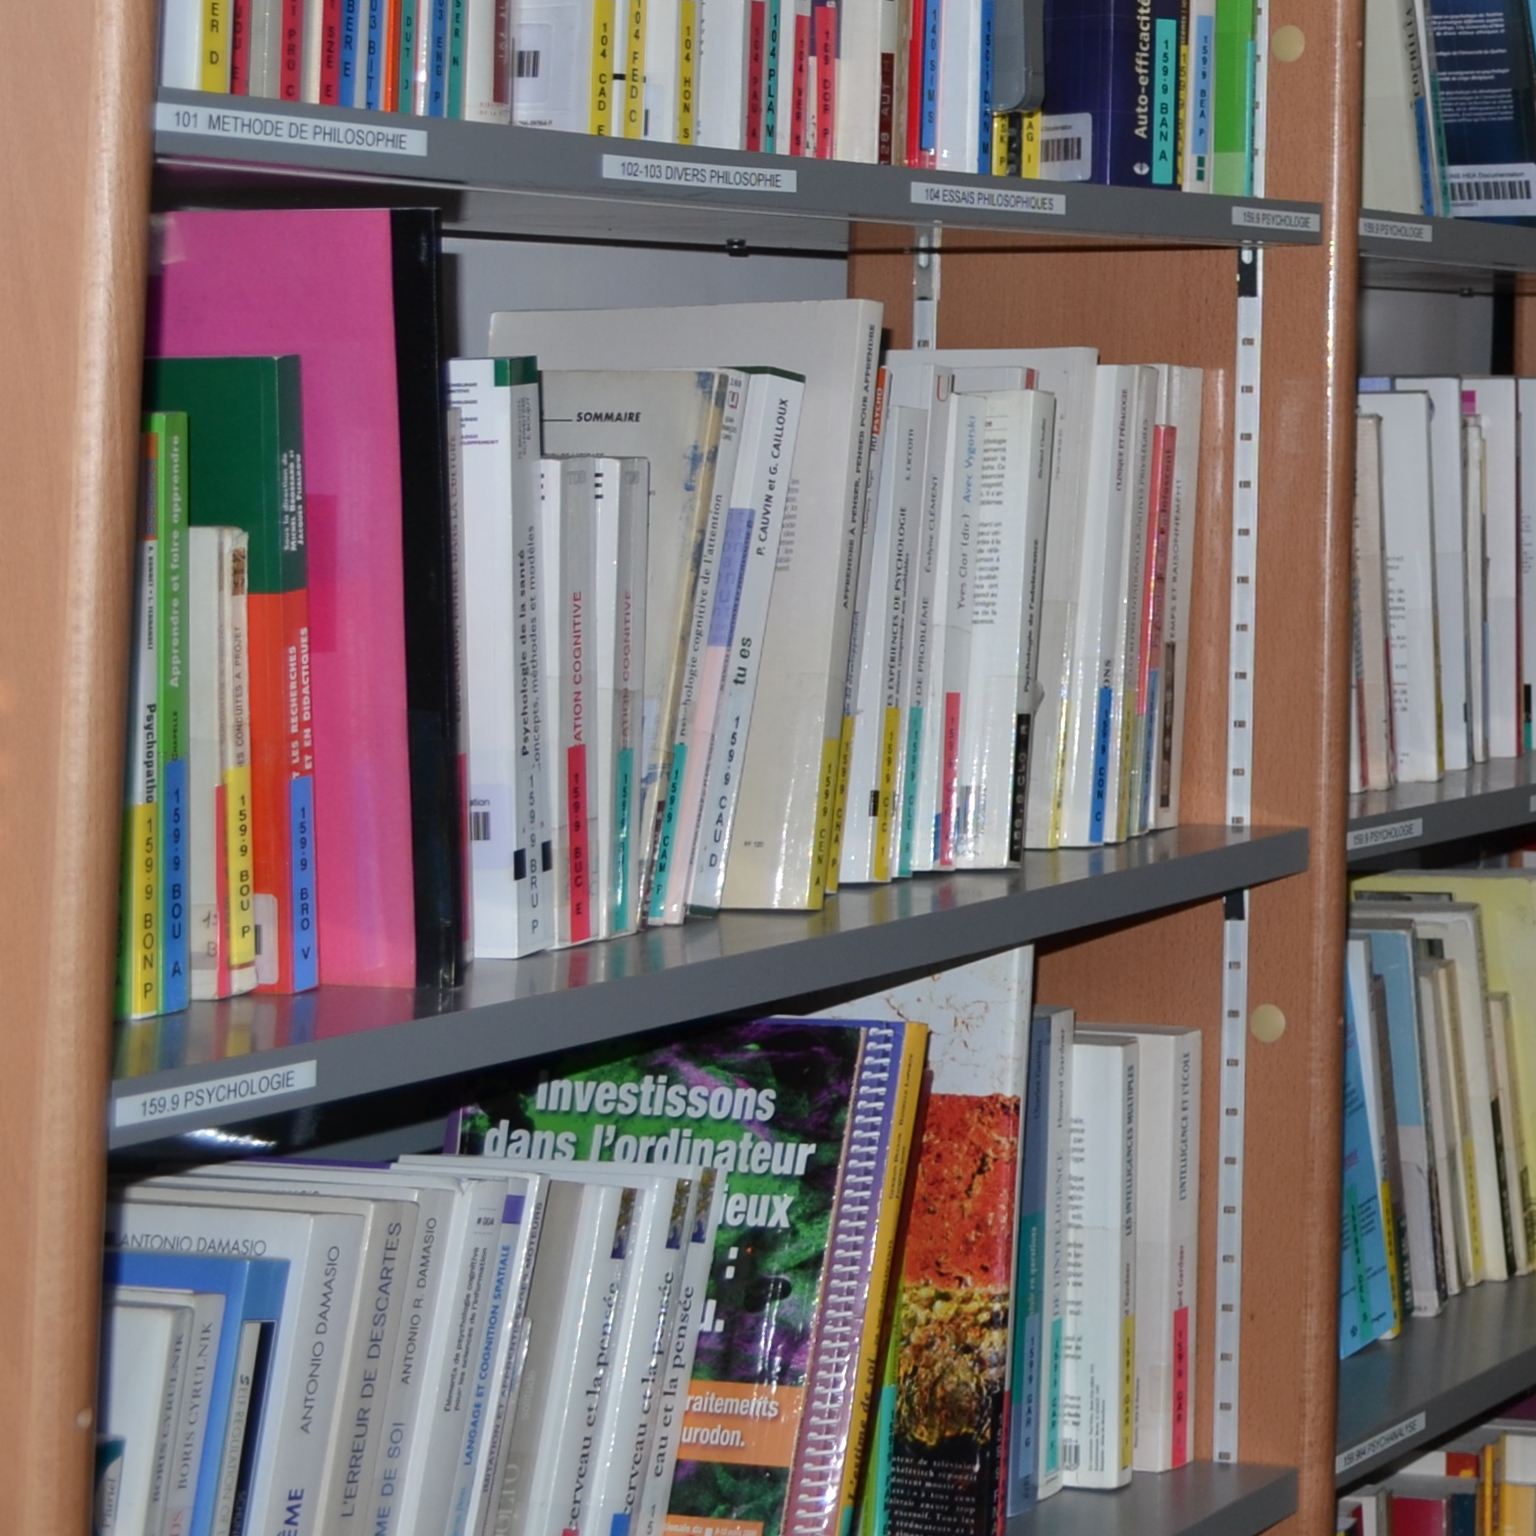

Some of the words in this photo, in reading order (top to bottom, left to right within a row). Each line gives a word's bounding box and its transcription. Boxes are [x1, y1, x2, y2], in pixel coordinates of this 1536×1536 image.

[209, 50, 220, 66] D
[173, 111, 199, 131] 101
[208, 113, 283, 138] METHODE
[288, 122, 308, 140] DE
[312, 125, 407, 151] PHILOSOPHIE
[1159, 101, 1169, 143] BAN
[620, 160, 663, 180] 102-103
[665, 165, 708, 184] DIVERS
[709, 169, 782, 189] PHILOSOPHIE
[1158, 149, 1168, 163] A
[924, 188, 941, 202] 104
[942, 189, 976, 206] ESSAIS
[977, 192, 1054, 211] PHILOSOPHIQUES
[1261, 213, 1311, 229] PSYCHOLOGIE
[1380, 223, 1425, 239] PSYCHOLOGIE
[576, 411, 642, 423] SOMMAIRE
[171, 435, 182, 524] apprendre
[169, 529, 181, 570] faire
[170, 574, 181, 591] et
[169, 598, 182, 687] Apprendre
[287, 646, 300, 733] RECHERCHES
[289, 739, 301, 763] LES
[1370, 823, 1414, 844] PSYCHOLOGIE
[142, 912, 154, 970] BON
[143, 982, 154, 1000] P
[140, 1093, 181, 1117] 159.9
[184, 1070, 295, 1109] PSYCHOLOGIE
[484, 1119, 577, 1162] dans
[720, 1183, 795, 1228] ieux
[121, 1233, 193, 1252] ANTONIO
[197, 1237, 268, 1257] DAMASIO
[366, 1221, 403, 1359] DESCARTES
[492, 1244, 511, 1301] SPATIALE
[299, 1341, 325, 1435] ANTONIO
[315, 1245, 341, 1334] DAMASIO
[479, 1305, 500, 1380] COGNITION
[359, 1367, 378, 1399] DE
[476, 1384, 486, 1398] ET
[177, 1431, 196, 1489] BORIS
[187, 1321, 213, 1425] CYRULNIK
[686, 1391, 778, 1420] raitements
[463, 1402, 482, 1466] LANGAGE
[340, 1407, 372, 1518] L'ERREUR
